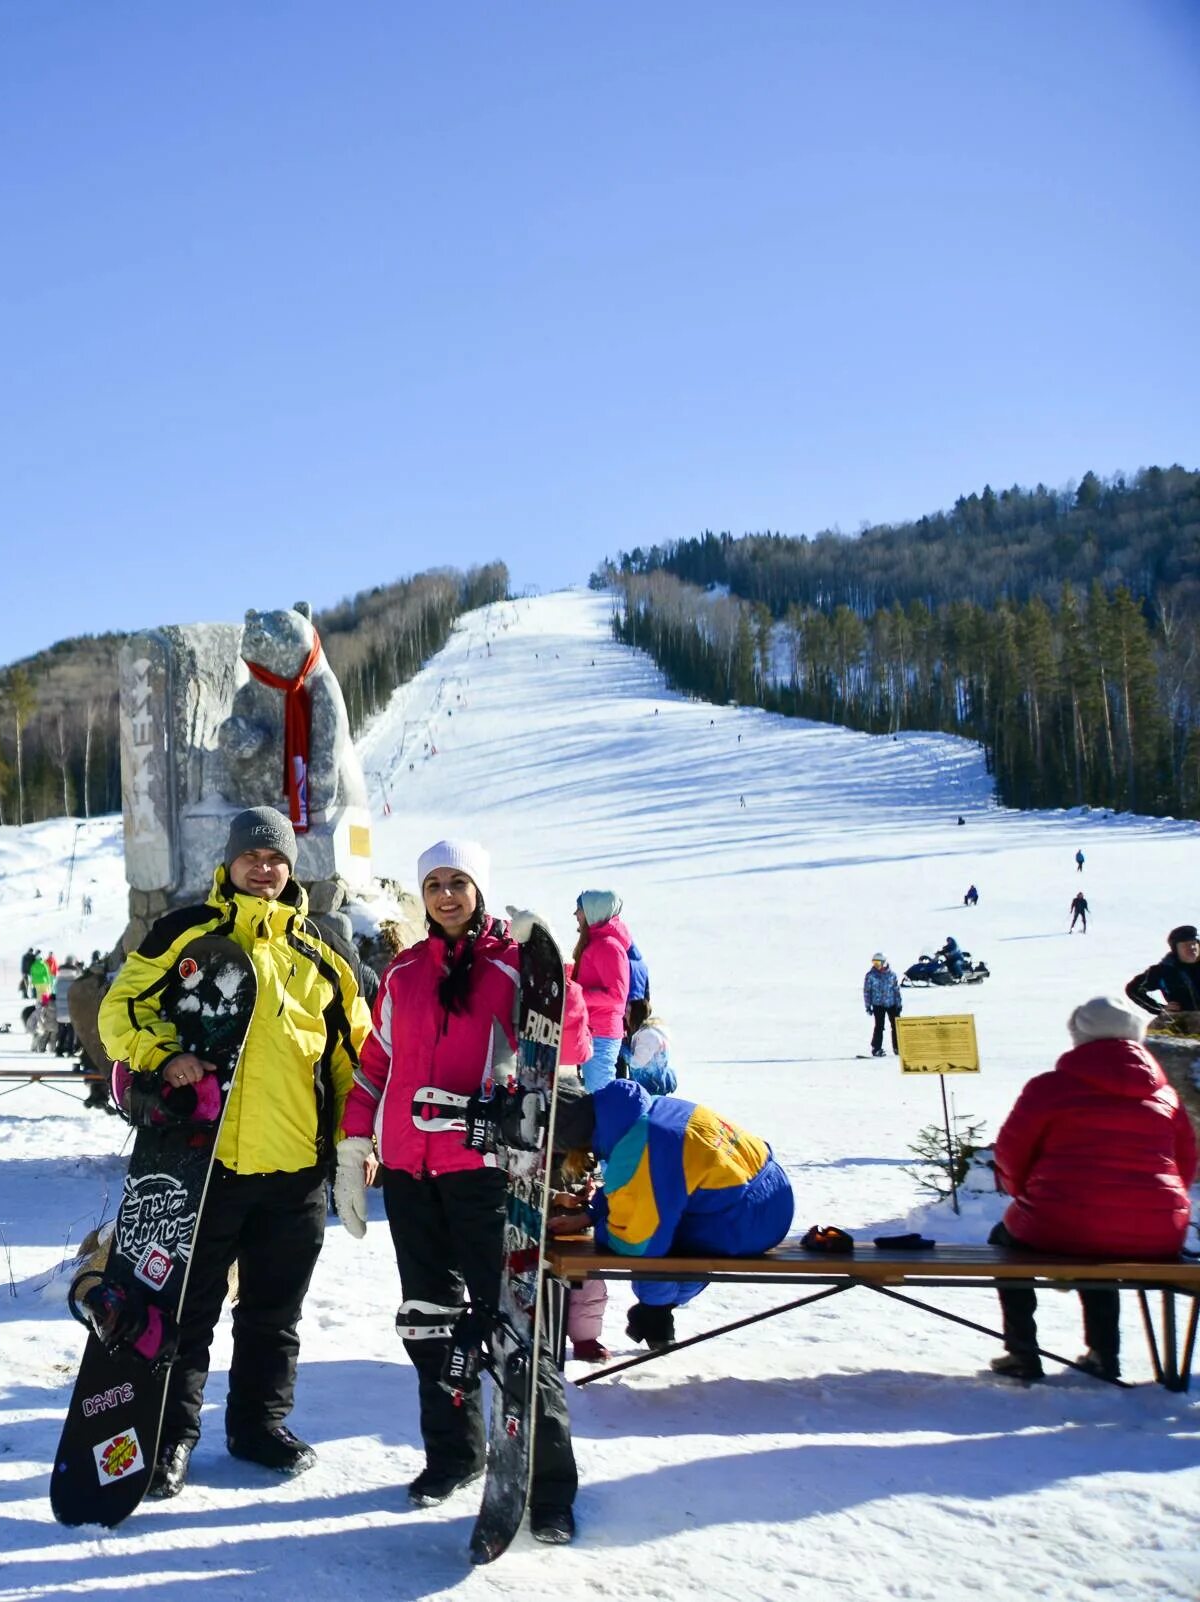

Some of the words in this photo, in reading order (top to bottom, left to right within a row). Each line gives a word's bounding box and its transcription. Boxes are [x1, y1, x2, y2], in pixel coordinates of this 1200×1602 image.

[525, 1008, 561, 1048] RIDE
[472, 1118, 486, 1147] RIDE
[137, 1246, 153, 1272] ELEMENT
